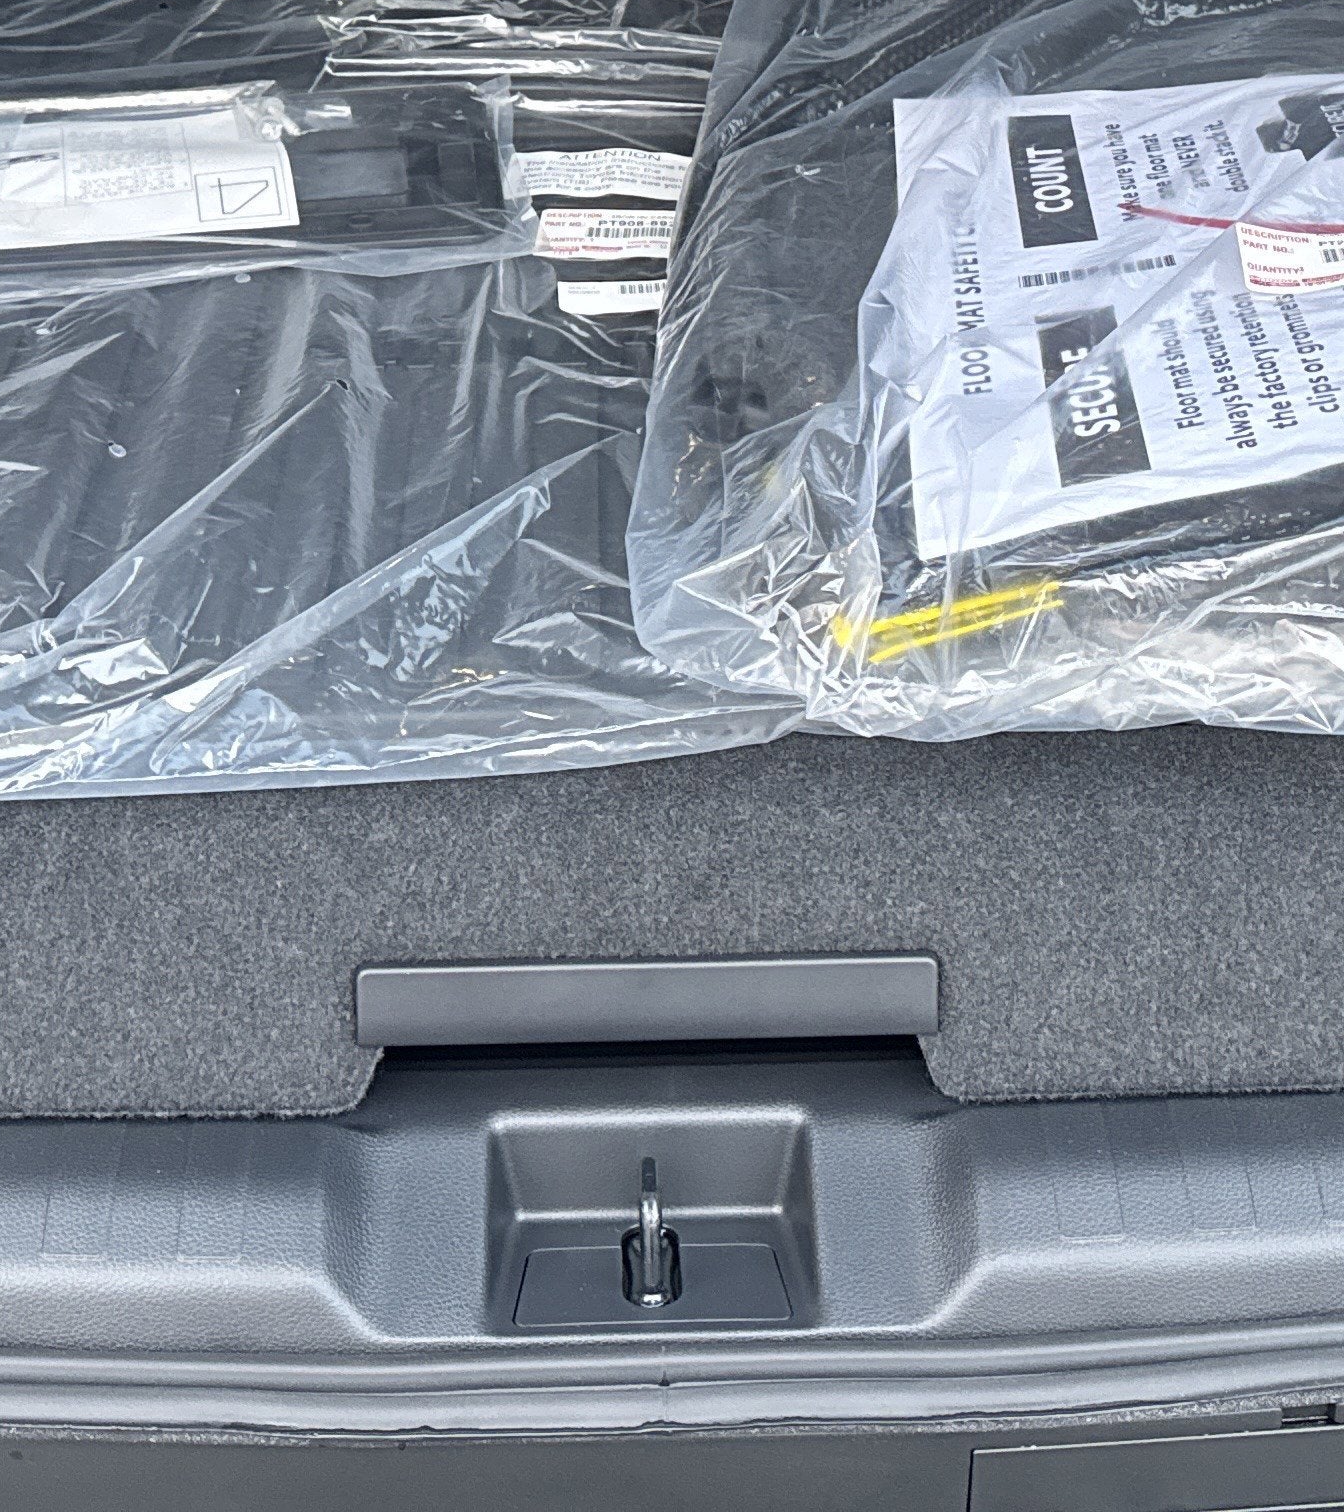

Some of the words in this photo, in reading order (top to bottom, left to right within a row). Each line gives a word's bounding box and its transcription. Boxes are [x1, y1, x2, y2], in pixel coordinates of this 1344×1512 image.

[1103, 123, 1125, 148] have
[1138, 133, 1161, 152] mat
[1172, 134, 1200, 169] NEVER
[1205, 131, 1236, 156] stack
[1111, 148, 1136, 167] you
[1145, 154, 1170, 179] floor
[1026, 146, 1074, 213] COUNT
[1116, 168, 1137, 190] sure
[1216, 158, 1249, 192] double
[1243, 239, 1268, 251] PART
[956, 300, 986, 332] MAT
[1187, 290, 1217, 324] using
[1229, 292, 1269, 347] retention
[1273, 293, 1324, 354] grommets
[1151, 318, 1186, 361] should
[1192, 325, 1233, 373] secured
[1164, 362, 1193, 389] mat
[1254, 348, 1288, 399] factory
[1301, 358, 1324, 373] or
[1211, 374, 1239, 396] be
[1306, 375, 1341, 413] clips
[1174, 392, 1205, 429] Floor
[1225, 395, 1258, 449] always
[1267, 400, 1298, 429] the
